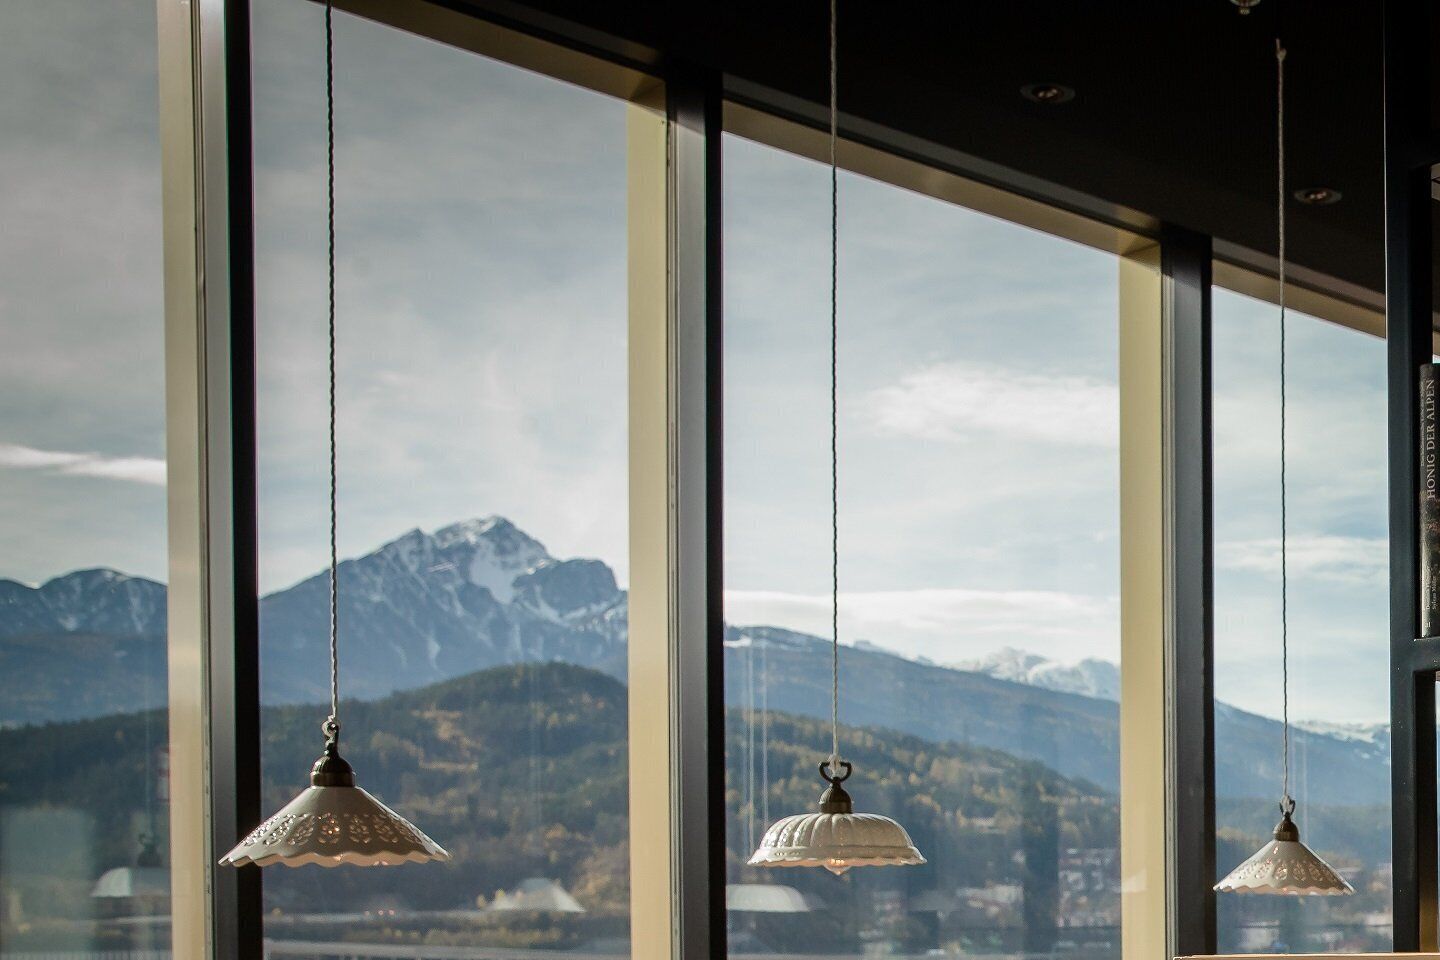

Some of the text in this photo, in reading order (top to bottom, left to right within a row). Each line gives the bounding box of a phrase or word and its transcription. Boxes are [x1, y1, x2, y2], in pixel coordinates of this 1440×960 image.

[1426, 379, 1436, 500] HONIG DER ALPEN
